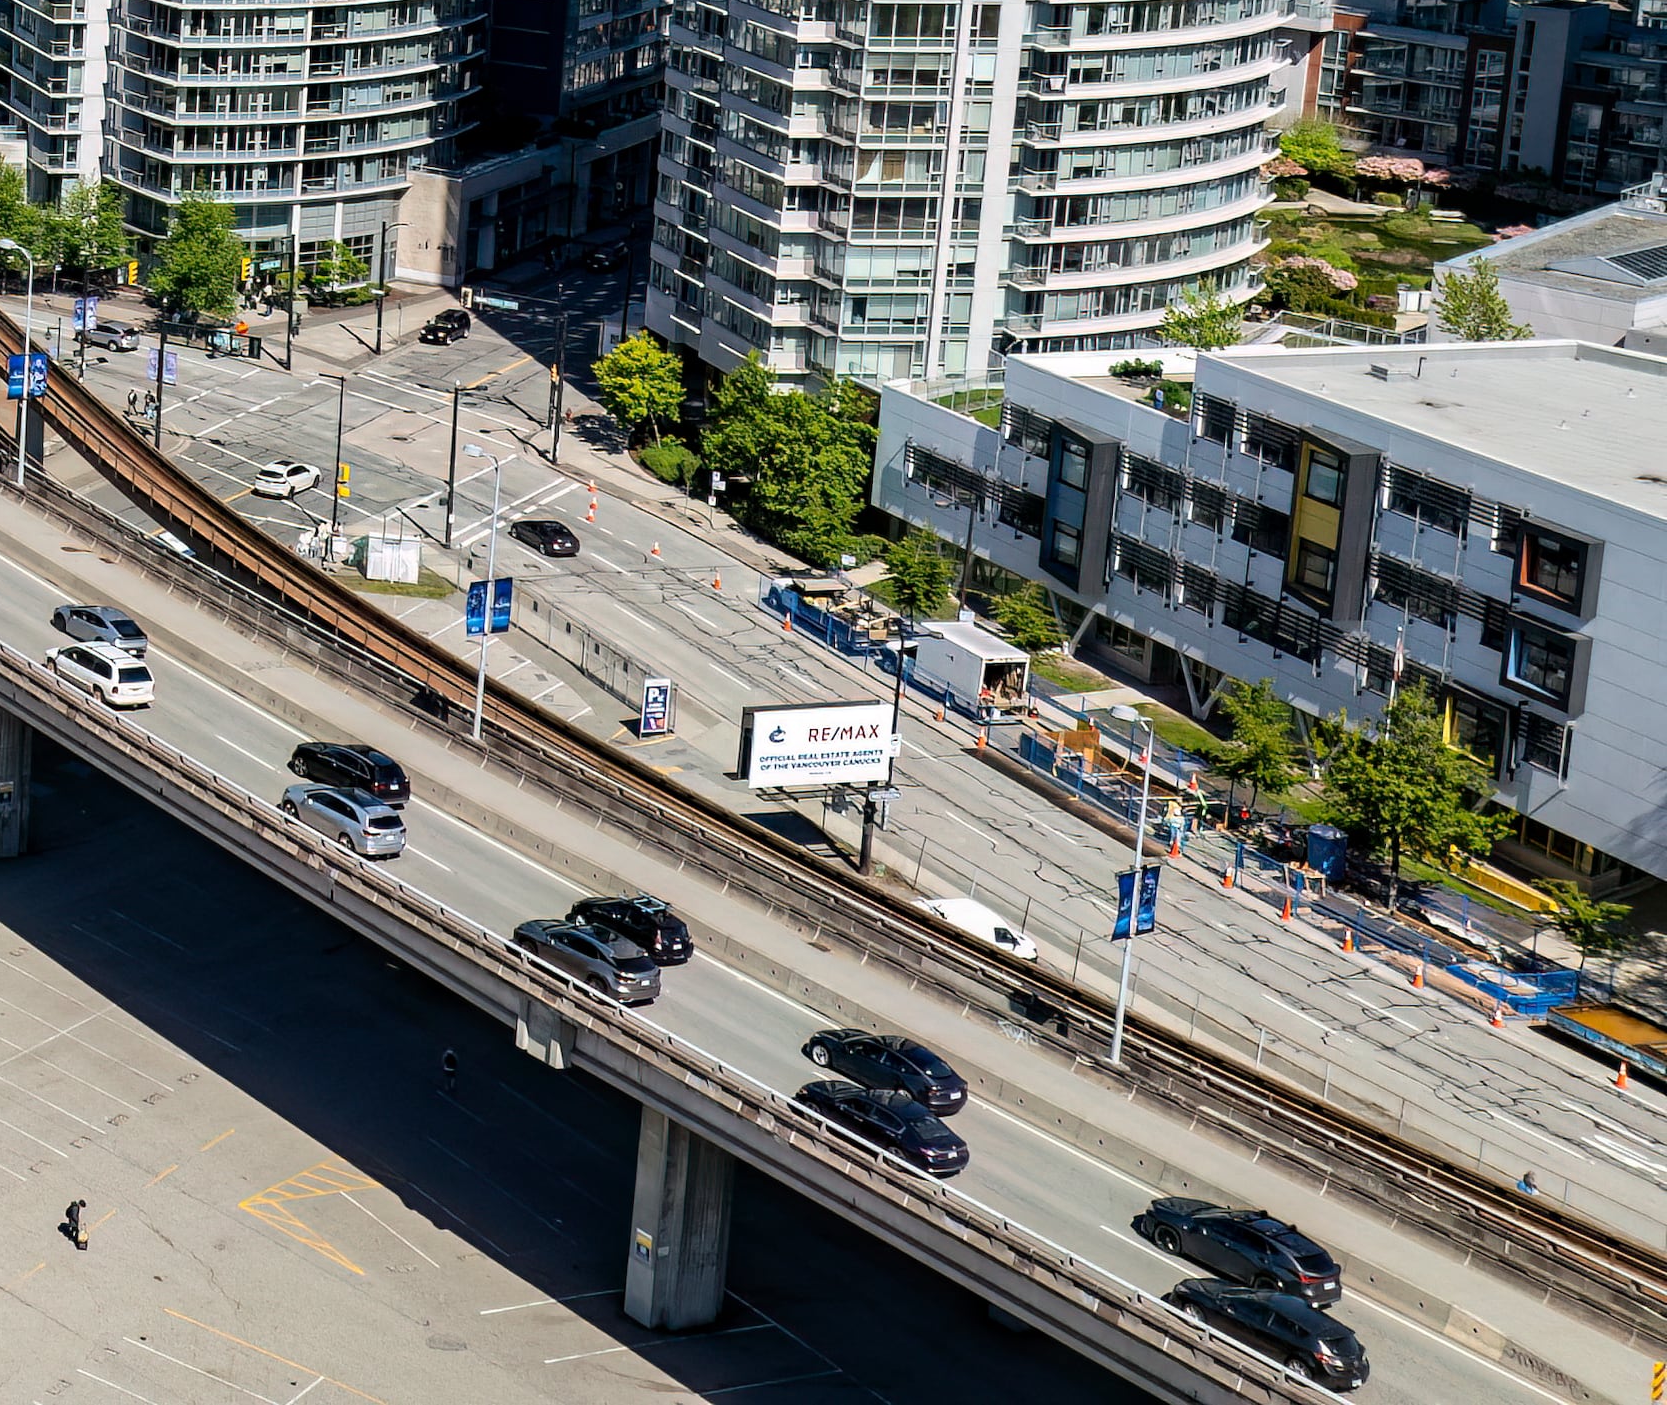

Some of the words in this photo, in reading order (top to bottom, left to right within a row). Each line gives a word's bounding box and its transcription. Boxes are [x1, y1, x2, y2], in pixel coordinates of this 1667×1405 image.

[808, 724, 880, 743] RE/MAX
[759, 754, 796, 763] OFFICIAL
[798, 752, 819, 761] REAL
[820, 751, 850, 760] ESTATE
[852, 749, 884, 757] AGENTS
[774, 763, 789, 771] THE
[791, 760, 841, 769] VANCOUVER
[842, 758, 881, 766] CANUCKS
